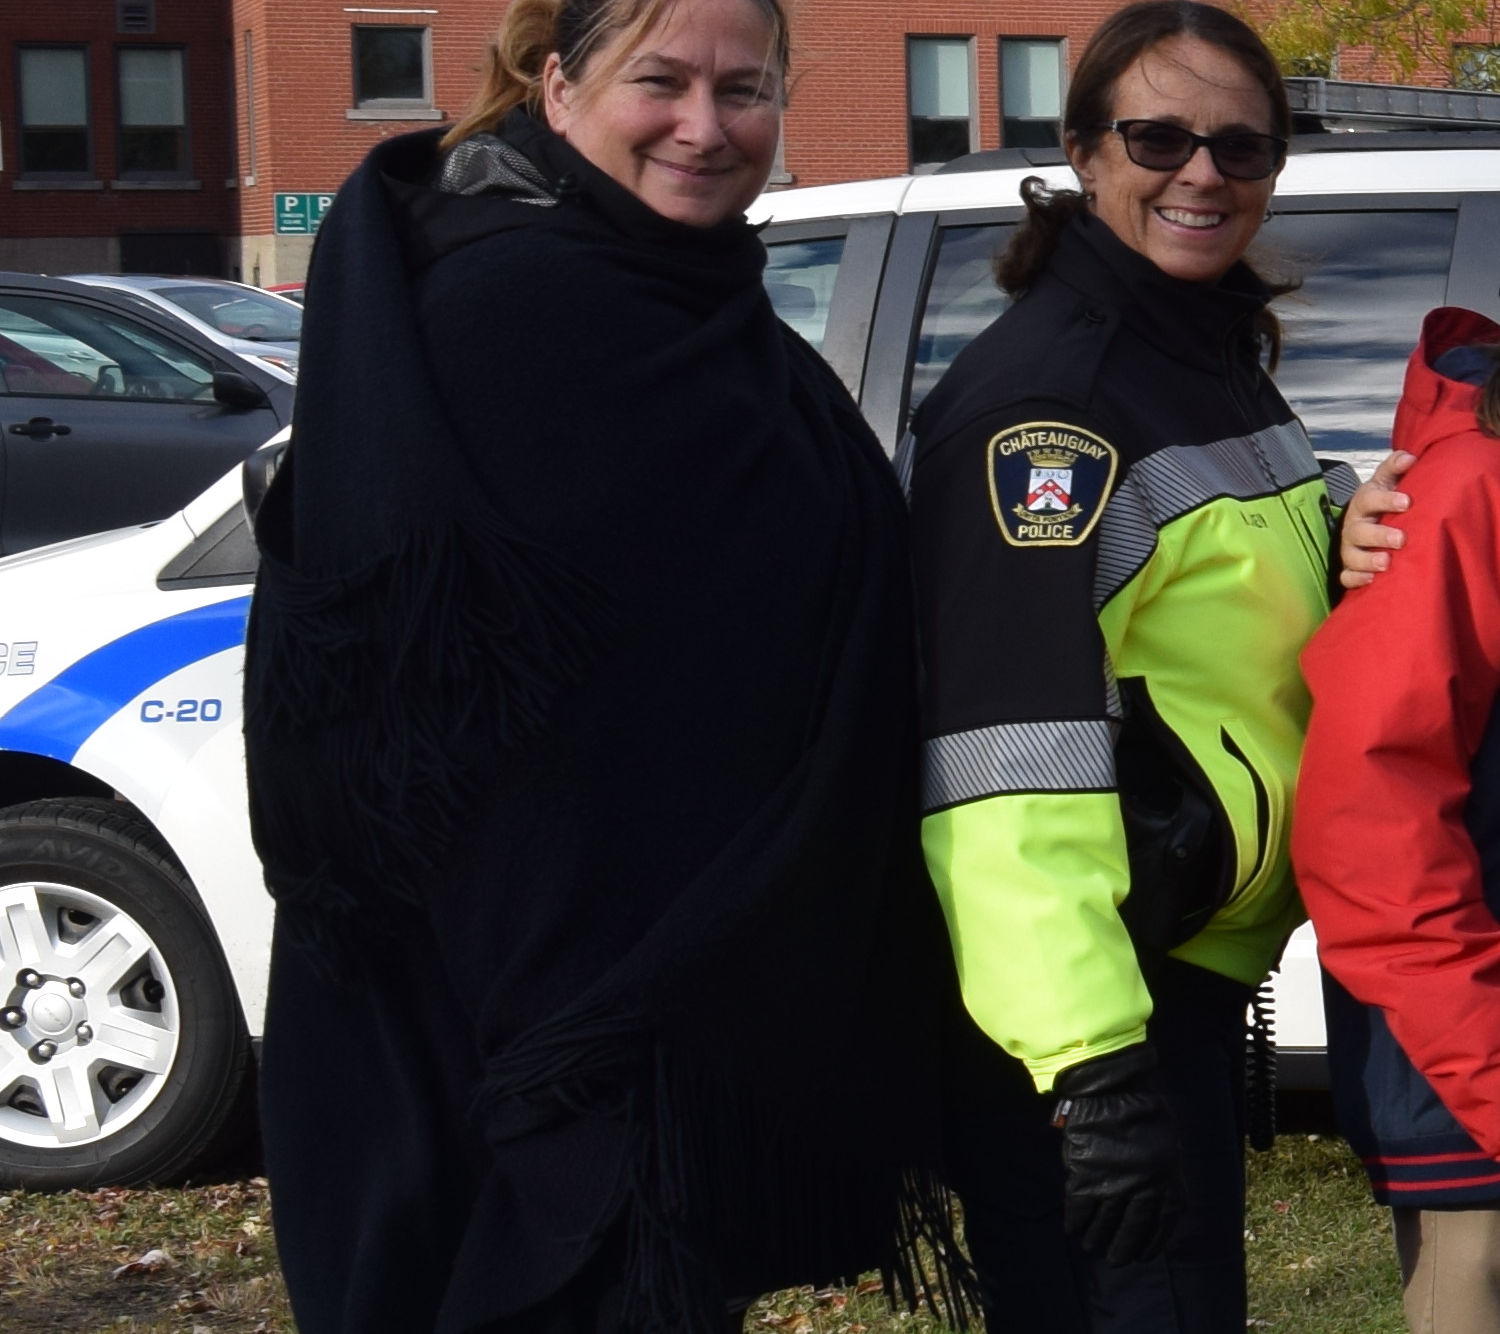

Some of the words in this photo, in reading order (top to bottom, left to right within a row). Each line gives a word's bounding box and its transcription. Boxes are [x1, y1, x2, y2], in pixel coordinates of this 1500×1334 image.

[285, 196, 299, 212] P
[1000, 431, 1108, 460] CHÂTEAUGUAY
[1017, 524, 1074, 539] POLICE
[140, 698, 222, 723] C-20
